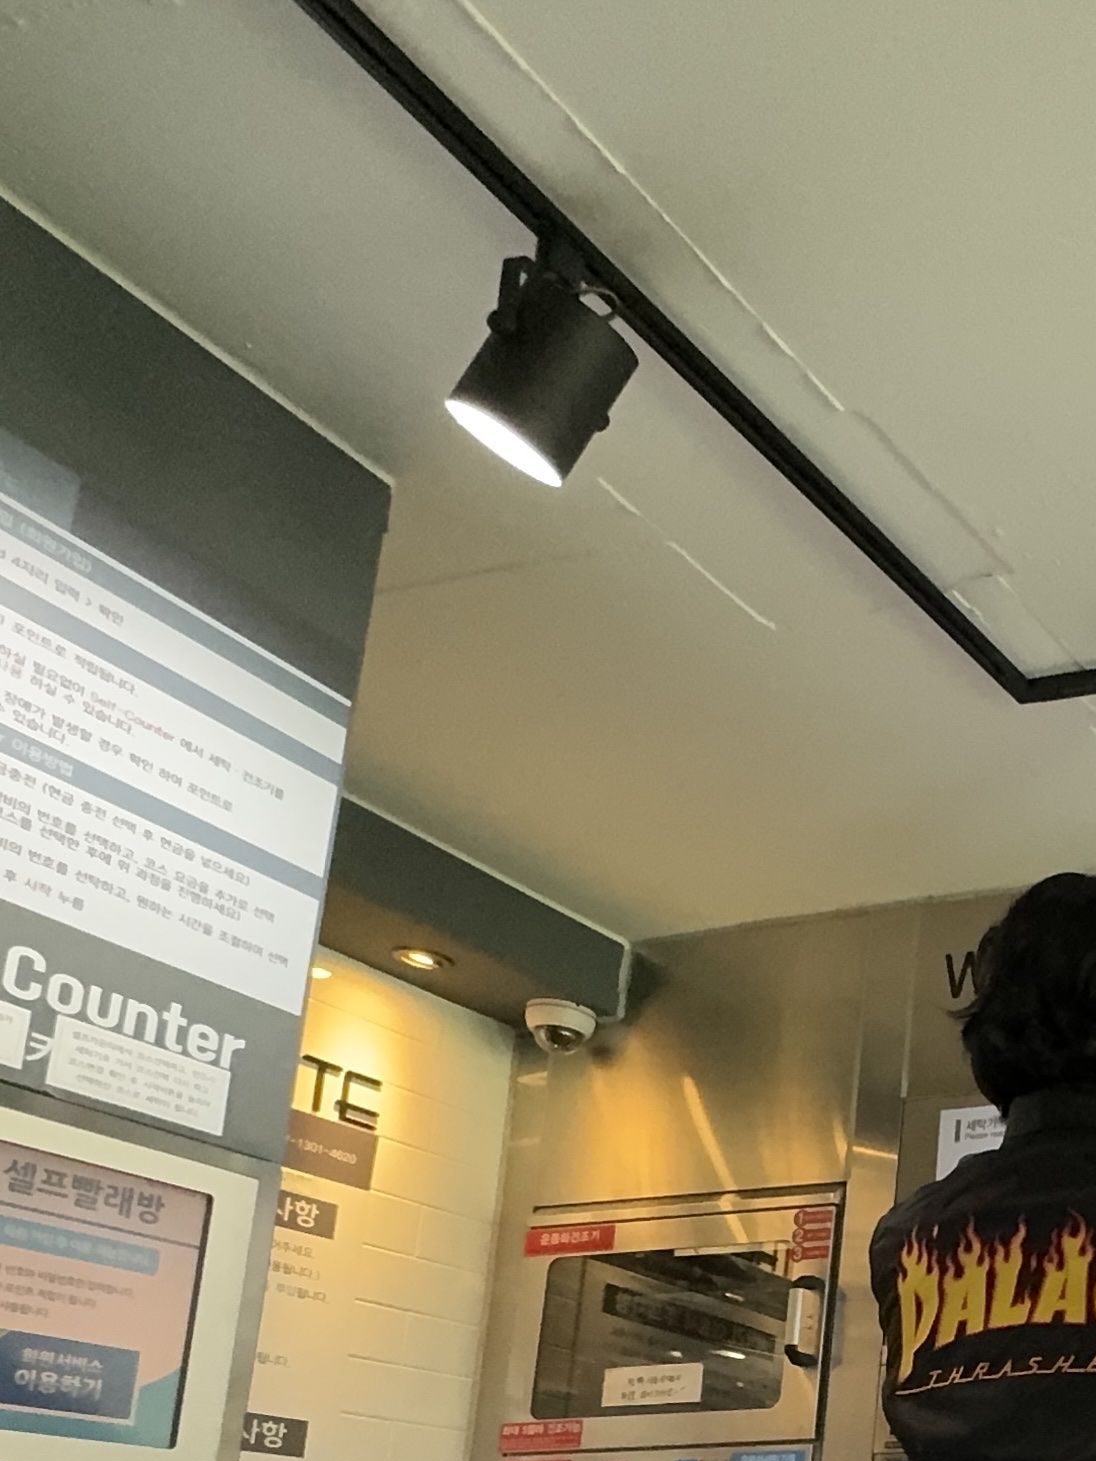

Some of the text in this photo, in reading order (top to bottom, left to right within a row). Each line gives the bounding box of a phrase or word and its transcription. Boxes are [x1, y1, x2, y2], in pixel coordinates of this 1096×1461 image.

[3, 945, 246, 1069] Counter
[3, 1159, 165, 1225] 셀프빨래방
[14, 1369, 104, 1401] 이용하기
